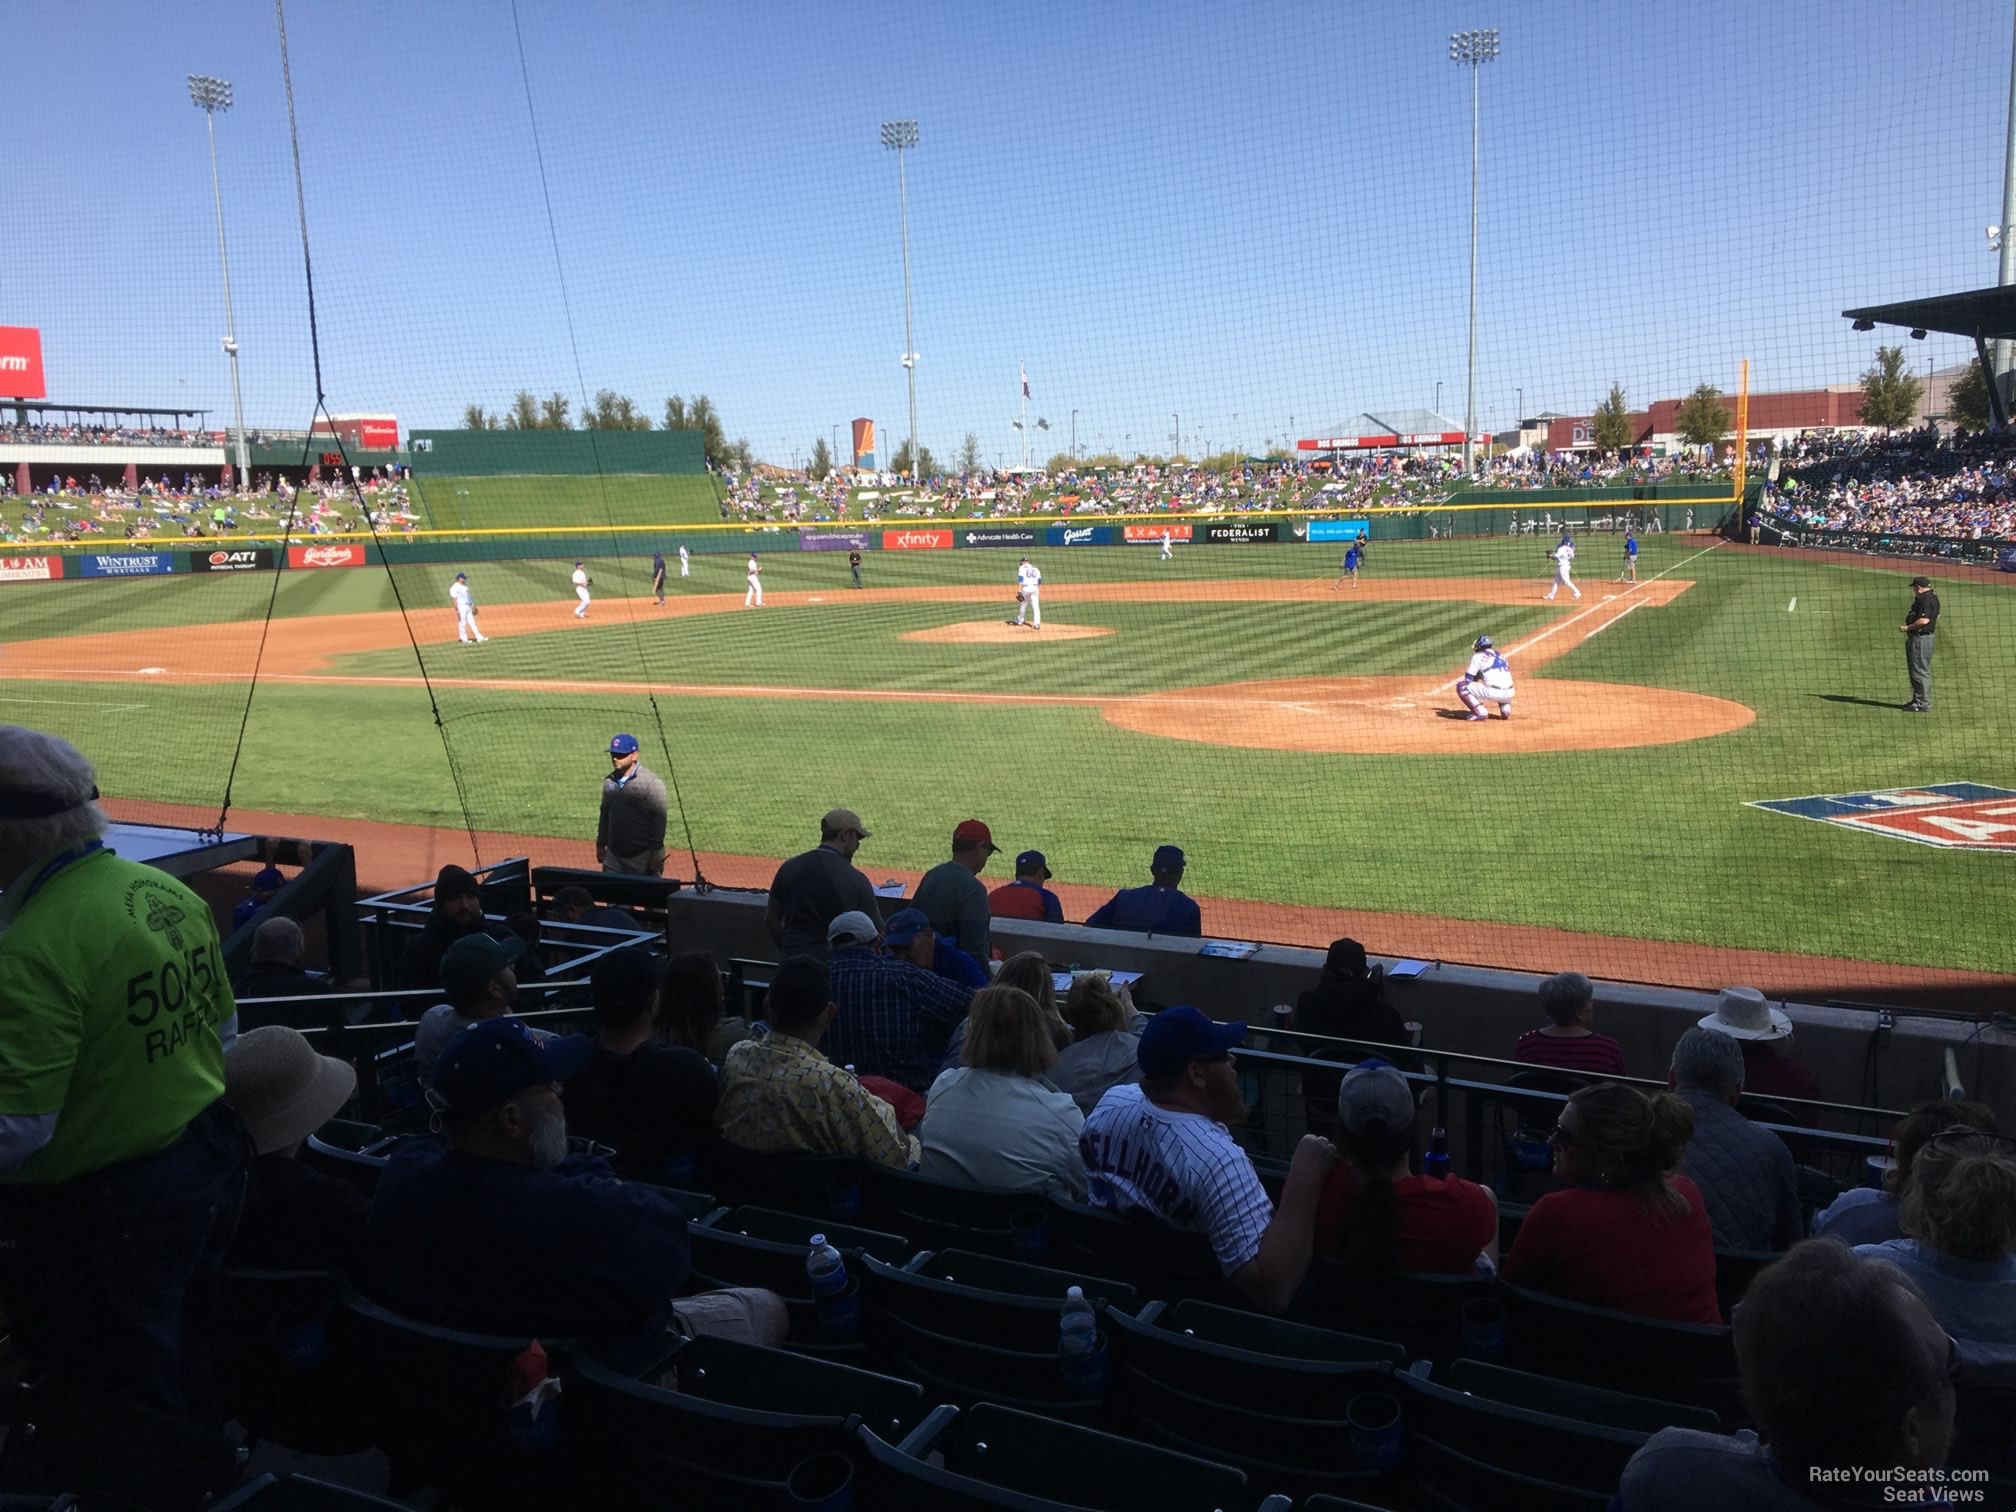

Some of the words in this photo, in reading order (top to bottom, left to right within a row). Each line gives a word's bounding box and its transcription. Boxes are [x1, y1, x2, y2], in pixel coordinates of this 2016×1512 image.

[0, 357, 27, 370] rm
[1317, 440, 1330, 448] DOS
[1332, 438, 1359, 447] GRINGOS
[977, 533, 1001, 541] Advocate
[1002, 533, 1020, 541] Health
[1210, 529, 1270, 537] FEDERALIST
[897, 532, 939, 547] xfinity
[228, 552, 256, 562] ATI
